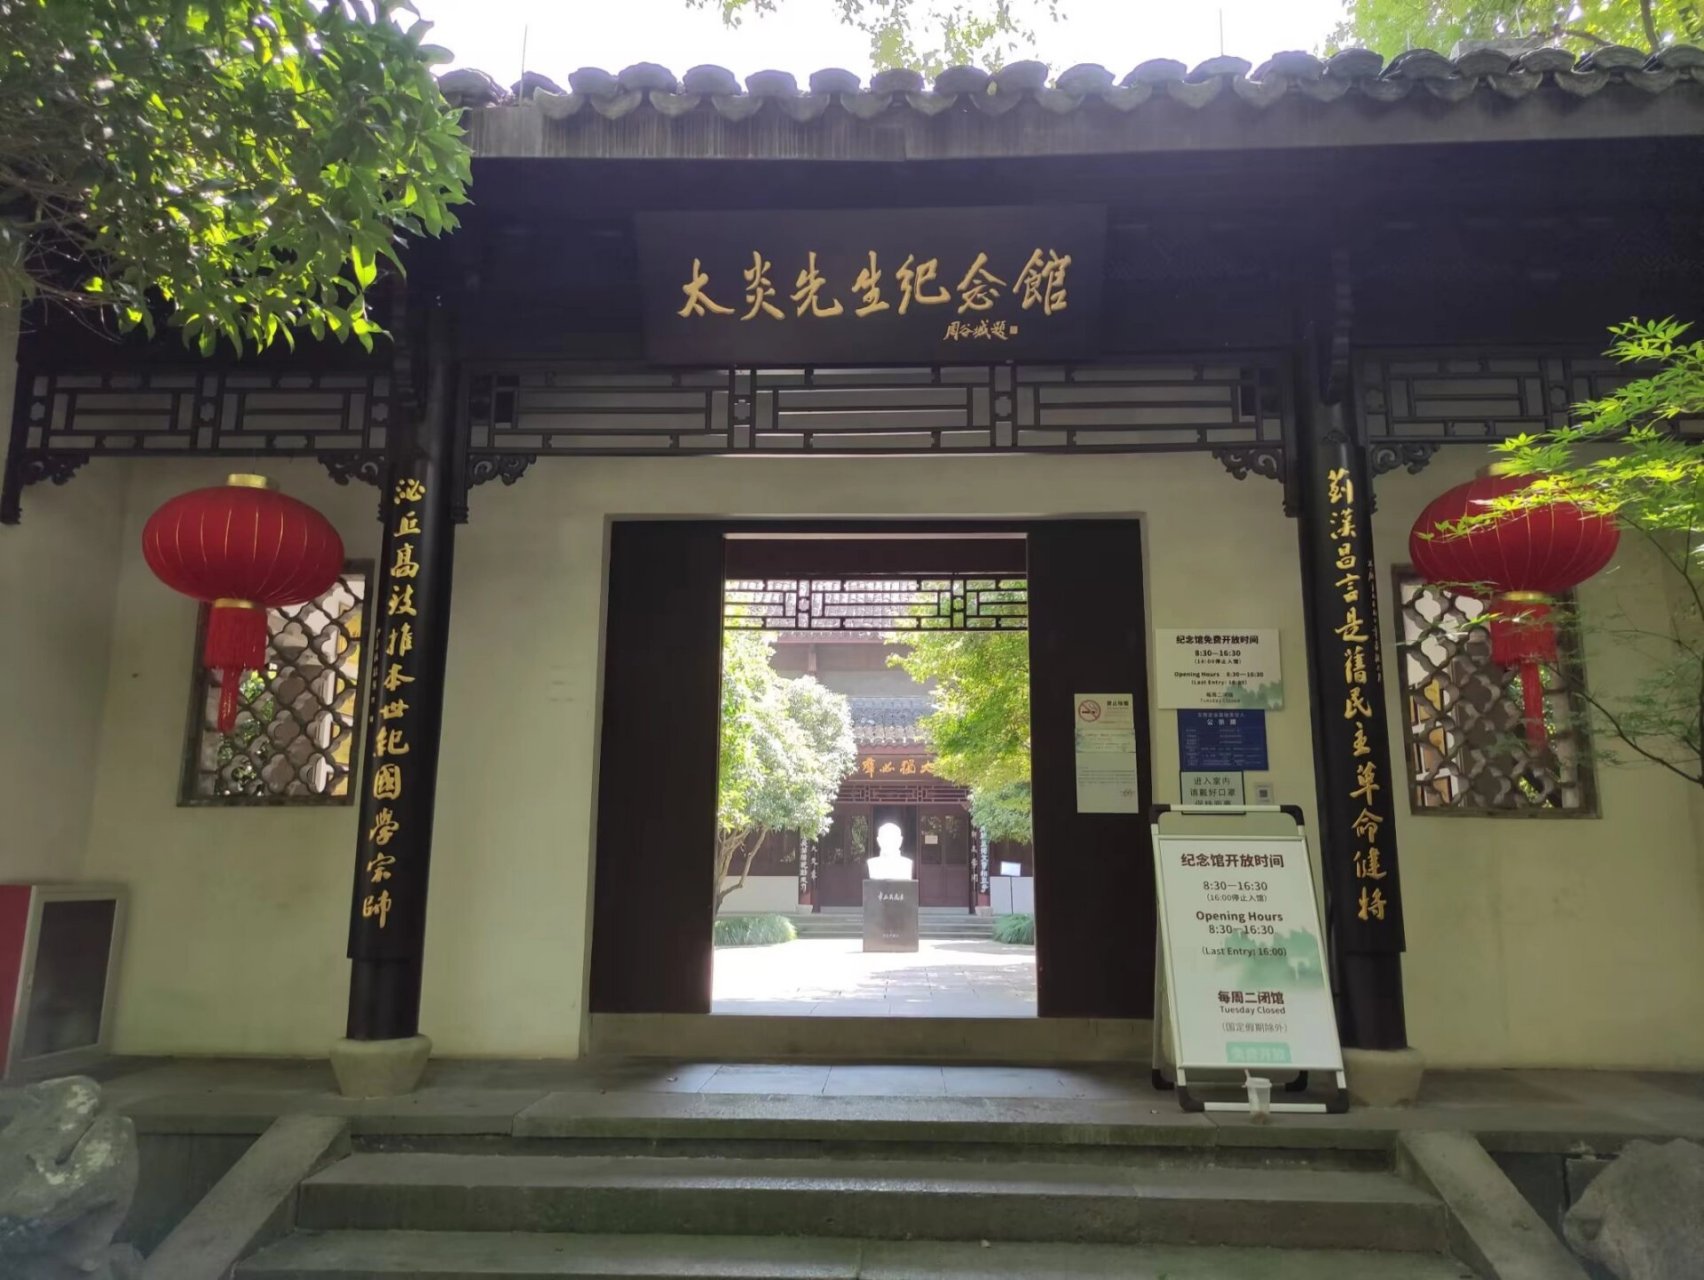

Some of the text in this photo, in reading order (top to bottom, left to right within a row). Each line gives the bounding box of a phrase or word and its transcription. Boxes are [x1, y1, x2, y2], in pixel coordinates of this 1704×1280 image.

[1176, 635, 1259, 645] 纪念馆免费开放时间
[1174, 671, 1200, 679] Opening
[1181, 853, 1284, 868] 纪念馆开放时间
[1196, 910, 1283, 923] Opening Hours
[1202, 947, 1227, 956] (Last
[1258, 947, 1287, 957] 16:00)
[1218, 991, 1284, 1004] 每周二闭馆
[1220, 1005, 1286, 1015] Tuesday Closed
